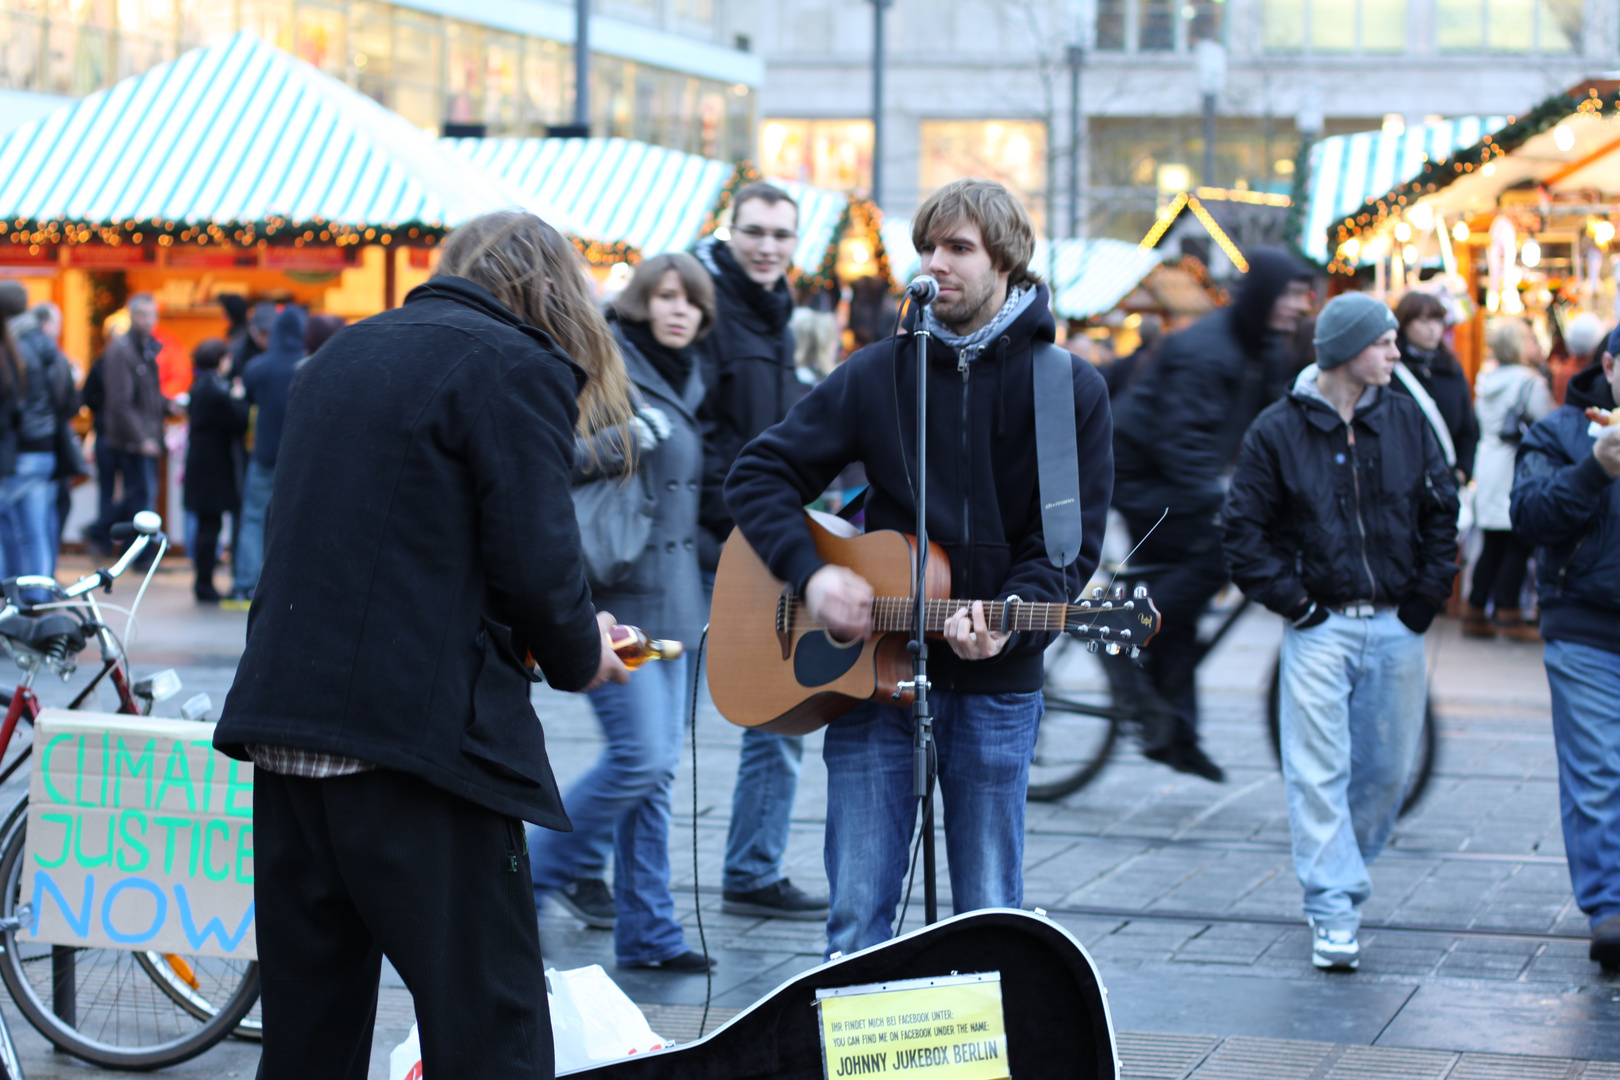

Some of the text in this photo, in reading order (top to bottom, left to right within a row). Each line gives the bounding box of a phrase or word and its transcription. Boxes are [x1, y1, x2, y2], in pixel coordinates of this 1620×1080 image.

[41, 730, 254, 818] CLIMATE
[33, 809, 254, 885] JUSTICE
[29, 869, 256, 953] NOW
[831, 1009, 955, 1033] IHR FINDET MICH BEI FACEBOOK UNTER:
[832, 1021, 991, 1048] YOU CAN FIND ME ON FACEBOOK UNDER THE NAME:
[836, 1040, 999, 1077] JOHNNY JUKEBOX BERLIN
